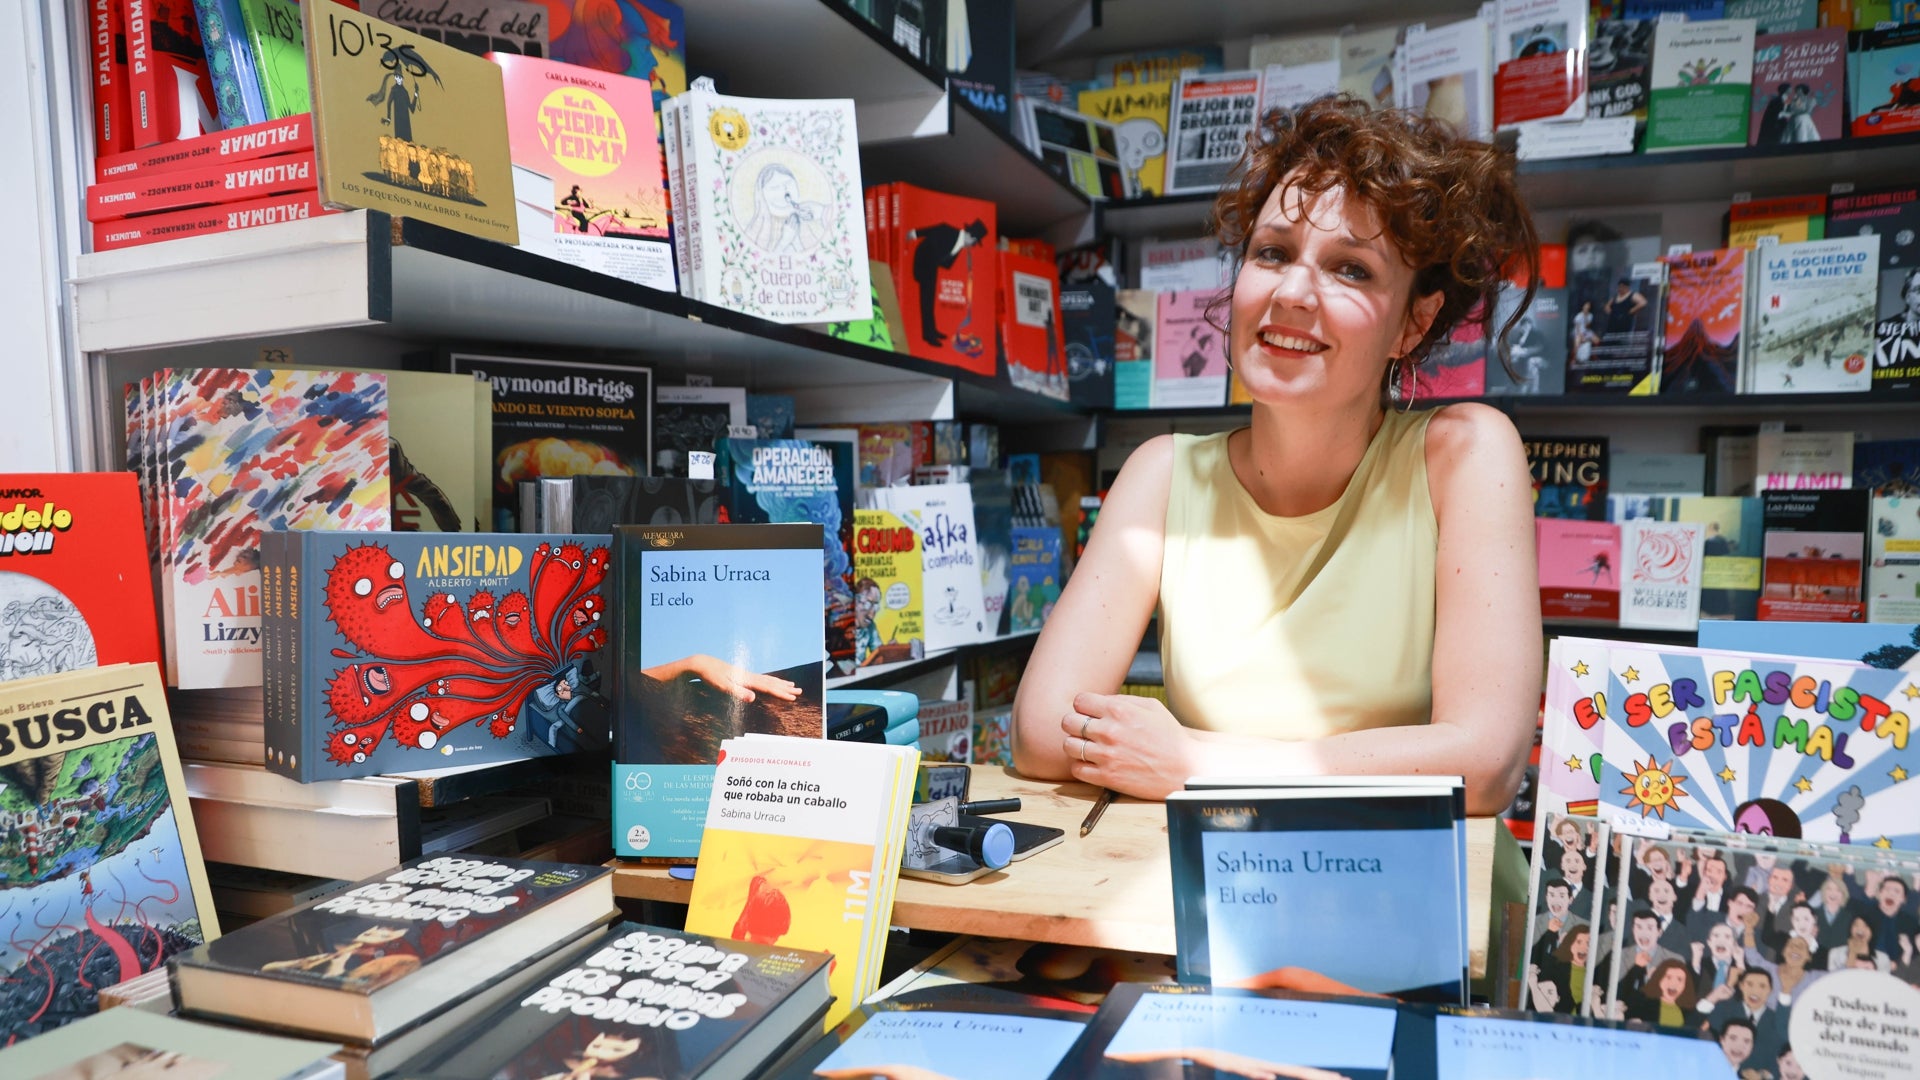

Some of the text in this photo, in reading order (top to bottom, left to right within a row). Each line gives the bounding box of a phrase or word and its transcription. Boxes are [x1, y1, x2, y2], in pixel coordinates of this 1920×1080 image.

[501, 12, 540, 38] del
[1784, 40, 1841, 62] SEÑORAS
[545, 72, 607, 90] CARLA BERROCAL
[1792, 67, 1824, 79] MUCHO
[562, 94, 596, 111] LA
[1182, 96, 1255, 114] MEJOR NO
[543, 106, 620, 140] TIERRA
[1180, 111, 1253, 130] BROMEAR
[538, 122, 624, 164] YERMA
[1209, 128, 1239, 142] CON
[108, 124, 300, 175] PALOMAR BETO HERNANDEZ VOLUMEN
[1207, 143, 1240, 159] ESTO
[105, 161, 309, 203] PALOMAR BETO HERNANDEZ VOLUMEN
[341, 182, 360, 194] LOS
[362, 186, 412, 206] PEQUEÑOS
[414, 200, 461, 218] MACABROS
[464, 212, 491, 226] Edward
[110, 201, 310, 242] PALOMAR BETO HERNANDEZ VOLUMEN
[779, 255, 792, 270] El
[1768, 252, 1868, 270] LA SOCIEDAD
[760, 268, 812, 289] Cuerpo
[1770, 264, 1864, 281] DE LA NIEVE
[758, 288, 817, 305] de Cristo
[573, 376, 635, 403] Briggs
[528, 404, 636, 420] EL VIENTO SOPLA
[515, 420, 566, 430] ROSA MONTERO
[752, 444, 833, 467] OPERACIÓN
[1524, 442, 1600, 458] STEPHEN
[752, 466, 833, 485] AMANECER
[1782, 502, 1815, 511] PRIMAS
[641, 532, 684, 540] ALFAGUARA
[858, 526, 915, 555] CRUMB
[416, 544, 524, 579] ANSIEDAD
[928, 548, 974, 569] completo
[428, 577, 509, 588] ALBERTO MONTT
[650, 564, 771, 583] Sabina Urraca
[263, 564, 272, 617] ANSIEDAD
[275, 566, 283, 619] ANSIEDAD
[289, 565, 298, 620] ANSIEDAD
[650, 592, 694, 607] El celo
[1634, 588, 1688, 599] WILLIAM
[202, 584, 262, 618] Ali
[1633, 598, 1688, 609] MORRIS
[203, 622, 262, 645] Lizzy
[17, 699, 54, 712] Brieva
[1623, 668, 1911, 750] SER FASCISTA
[1667, 702, 1855, 770] ESTÁ MAL
[730, 756, 812, 767] EPISODIOS NACIONALES
[625, 771, 652, 790] 60
[726, 775, 821, 793] Soñó con la chica
[723, 790, 848, 809] que robaba un caballo
[720, 807, 751, 820] Sabina
[753, 810, 786, 823] Urraca
[1202, 806, 1260, 818] ALFAGUARA
[634, 829, 645, 837] 2.ª
[1216, 850, 1383, 874] Sabina Urraca
[1218, 886, 1278, 904] El celo
[614, 930, 749, 973] SABINA
[769, 954, 806, 964] EDICIÓN
[586, 946, 733, 991] URRACA
[549, 968, 622, 996] LAS
[520, 986, 701, 1030] PRODIGIO
[1148, 999, 1319, 1019] Sabina Urraca
[1828, 994, 1907, 1018] Todos los
[875, 1016, 1024, 1034] Sabina Urraca
[1452, 1024, 1539, 1041] Sabina
[1813, 1008, 1920, 1038] hijos de puta
[862, 1030, 882, 1040] El
[1819, 1027, 1909, 1052] del mundo
